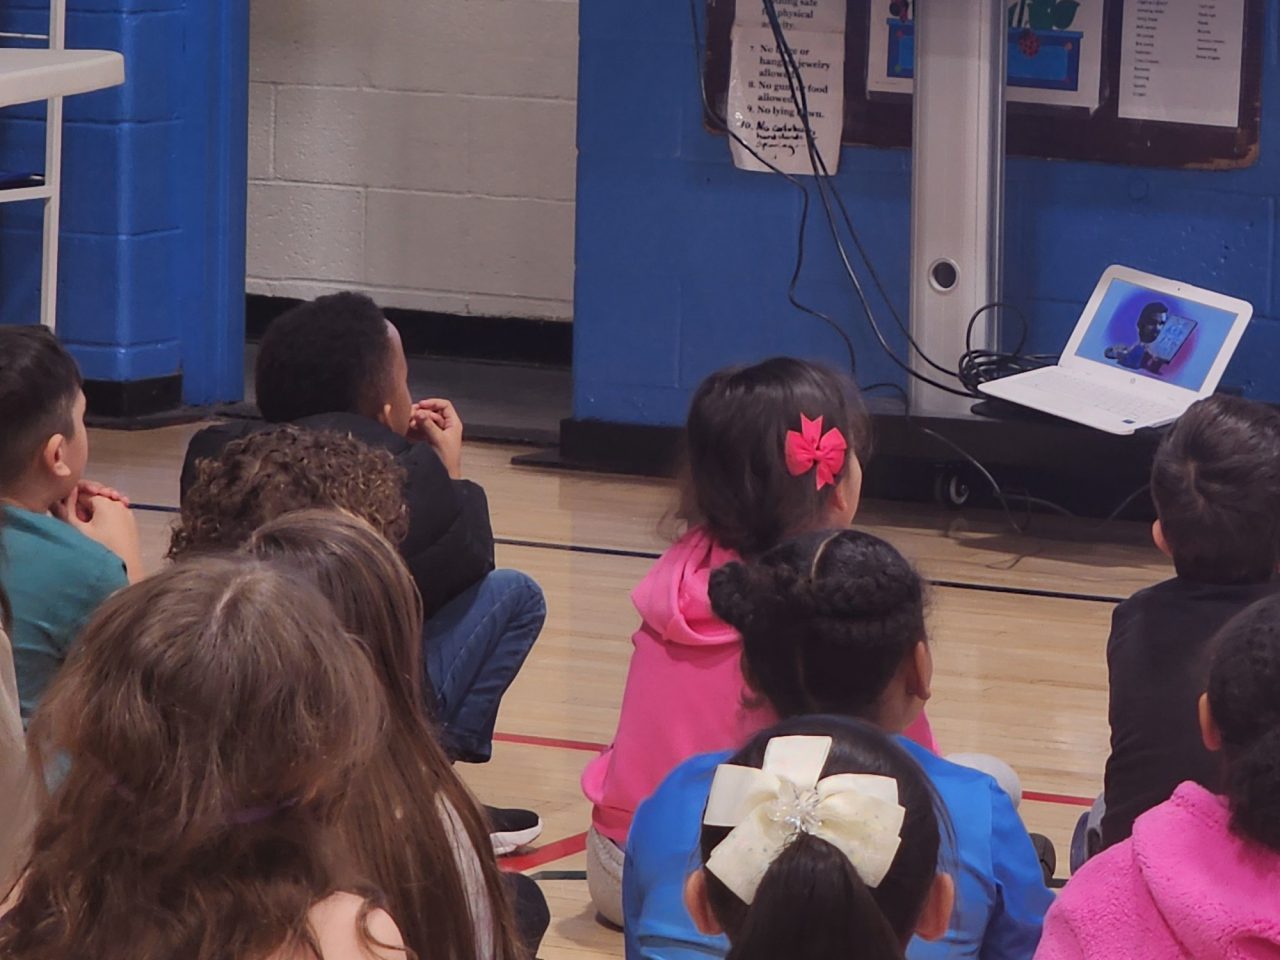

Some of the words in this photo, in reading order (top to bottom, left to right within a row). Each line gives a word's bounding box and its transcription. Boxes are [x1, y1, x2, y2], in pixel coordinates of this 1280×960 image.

[777, 9, 814, 20] physical
[799, 48, 810, 56] or
[758, 81, 772, 90] No
[807, 84, 829, 94] food
[757, 106, 771, 114] No
[772, 106, 795, 117] lying
